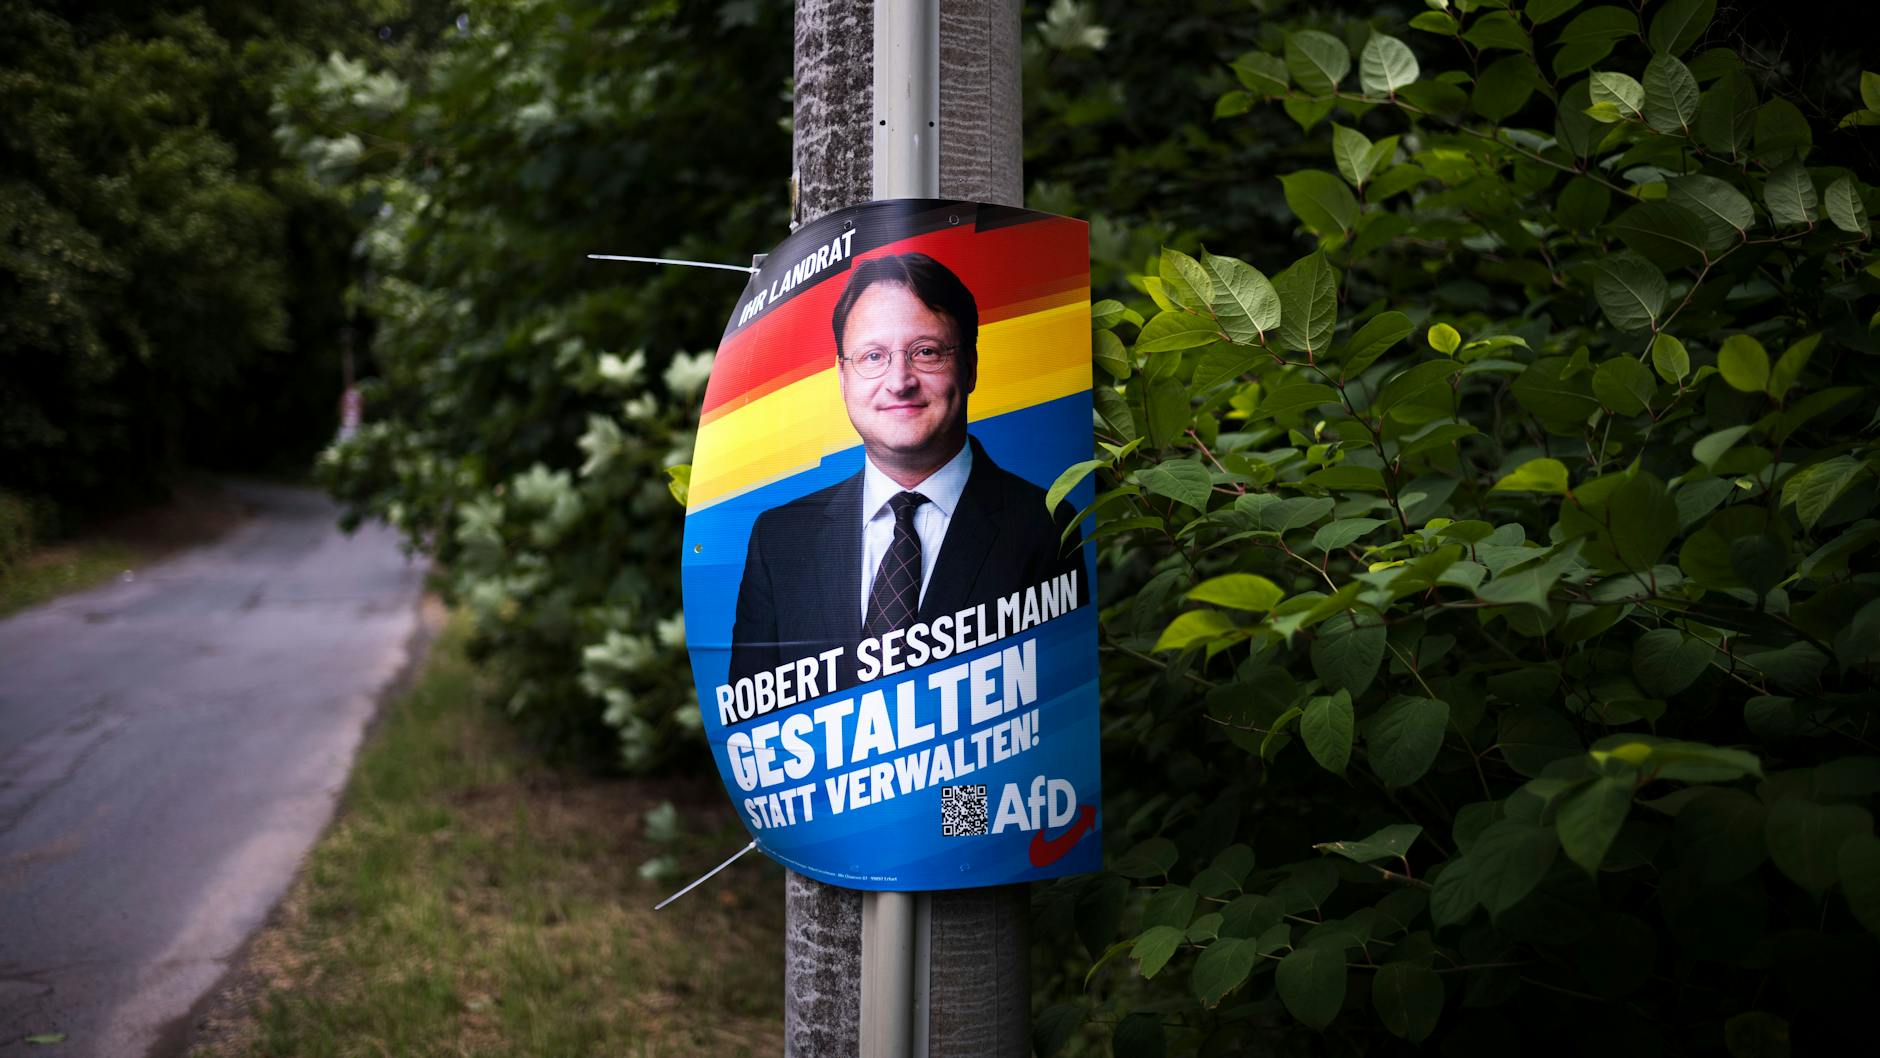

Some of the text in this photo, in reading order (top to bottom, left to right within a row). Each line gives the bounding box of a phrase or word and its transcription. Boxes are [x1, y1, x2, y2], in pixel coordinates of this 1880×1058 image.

[738, 228, 856, 327] IHR LANDRAT
[716, 569, 1078, 726] ROBERT SESSELMANN
[726, 638, 1038, 792] GESTALTEN
[744, 708, 1040, 830] STATT VERWALTEN!
[991, 774, 1077, 834] AfD
